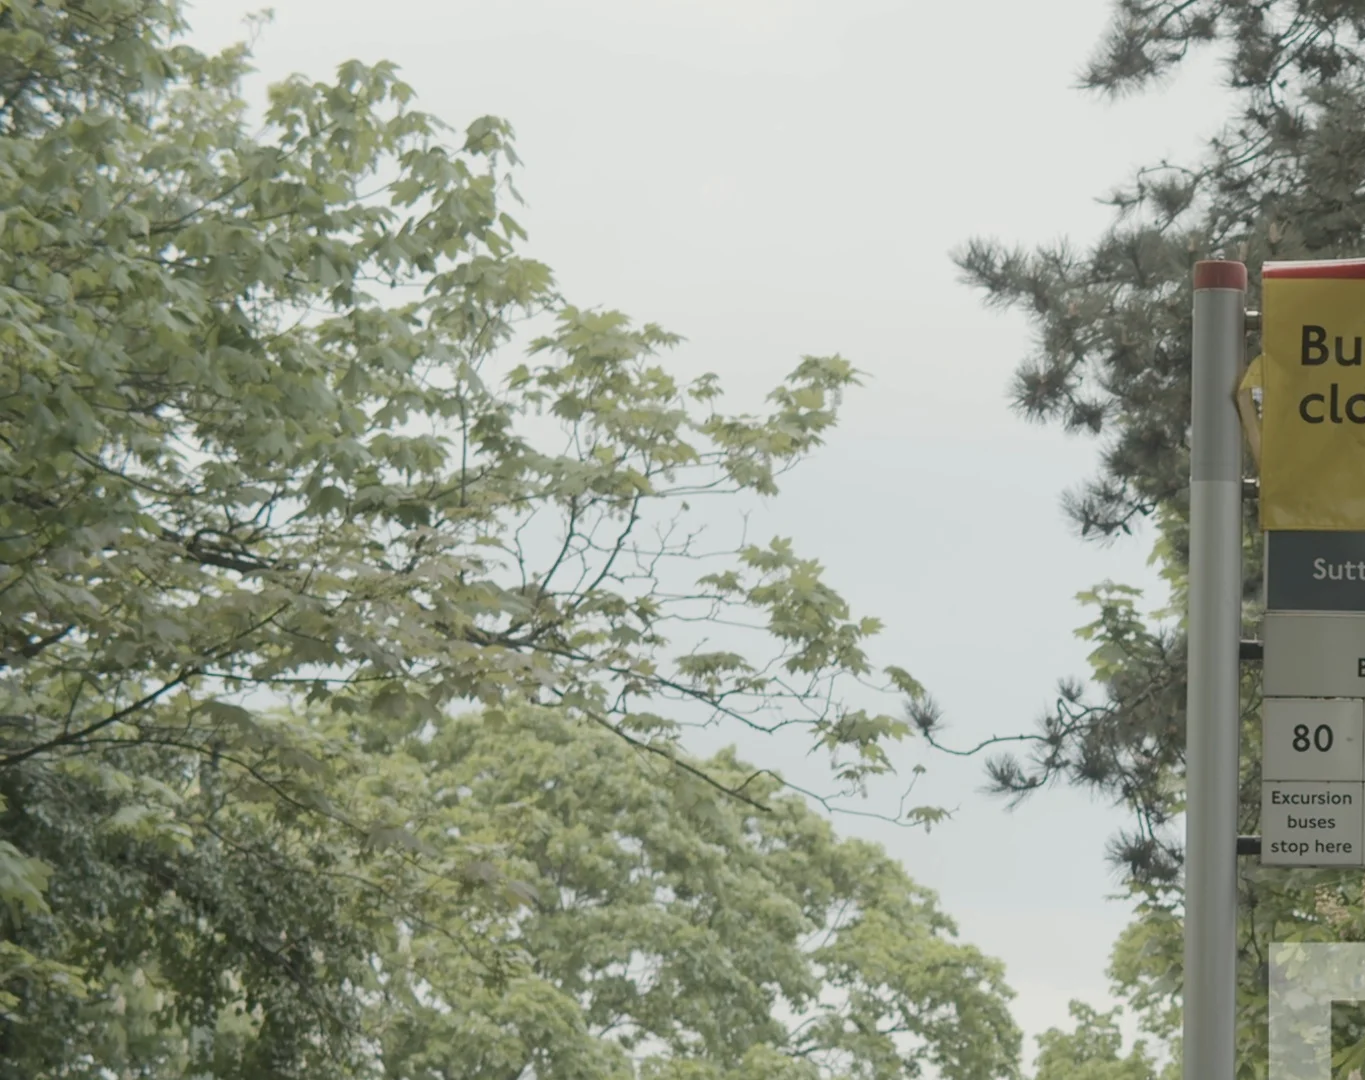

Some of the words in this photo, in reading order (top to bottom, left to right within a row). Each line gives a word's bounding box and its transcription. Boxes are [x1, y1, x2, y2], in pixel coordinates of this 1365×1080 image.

[1292, 724, 1334, 753] 80
[1271, 791, 1352, 806] Excursion
[1287, 814, 1336, 830] buses
[1271, 840, 1311, 856] stop
[1315, 839, 1352, 854] here
